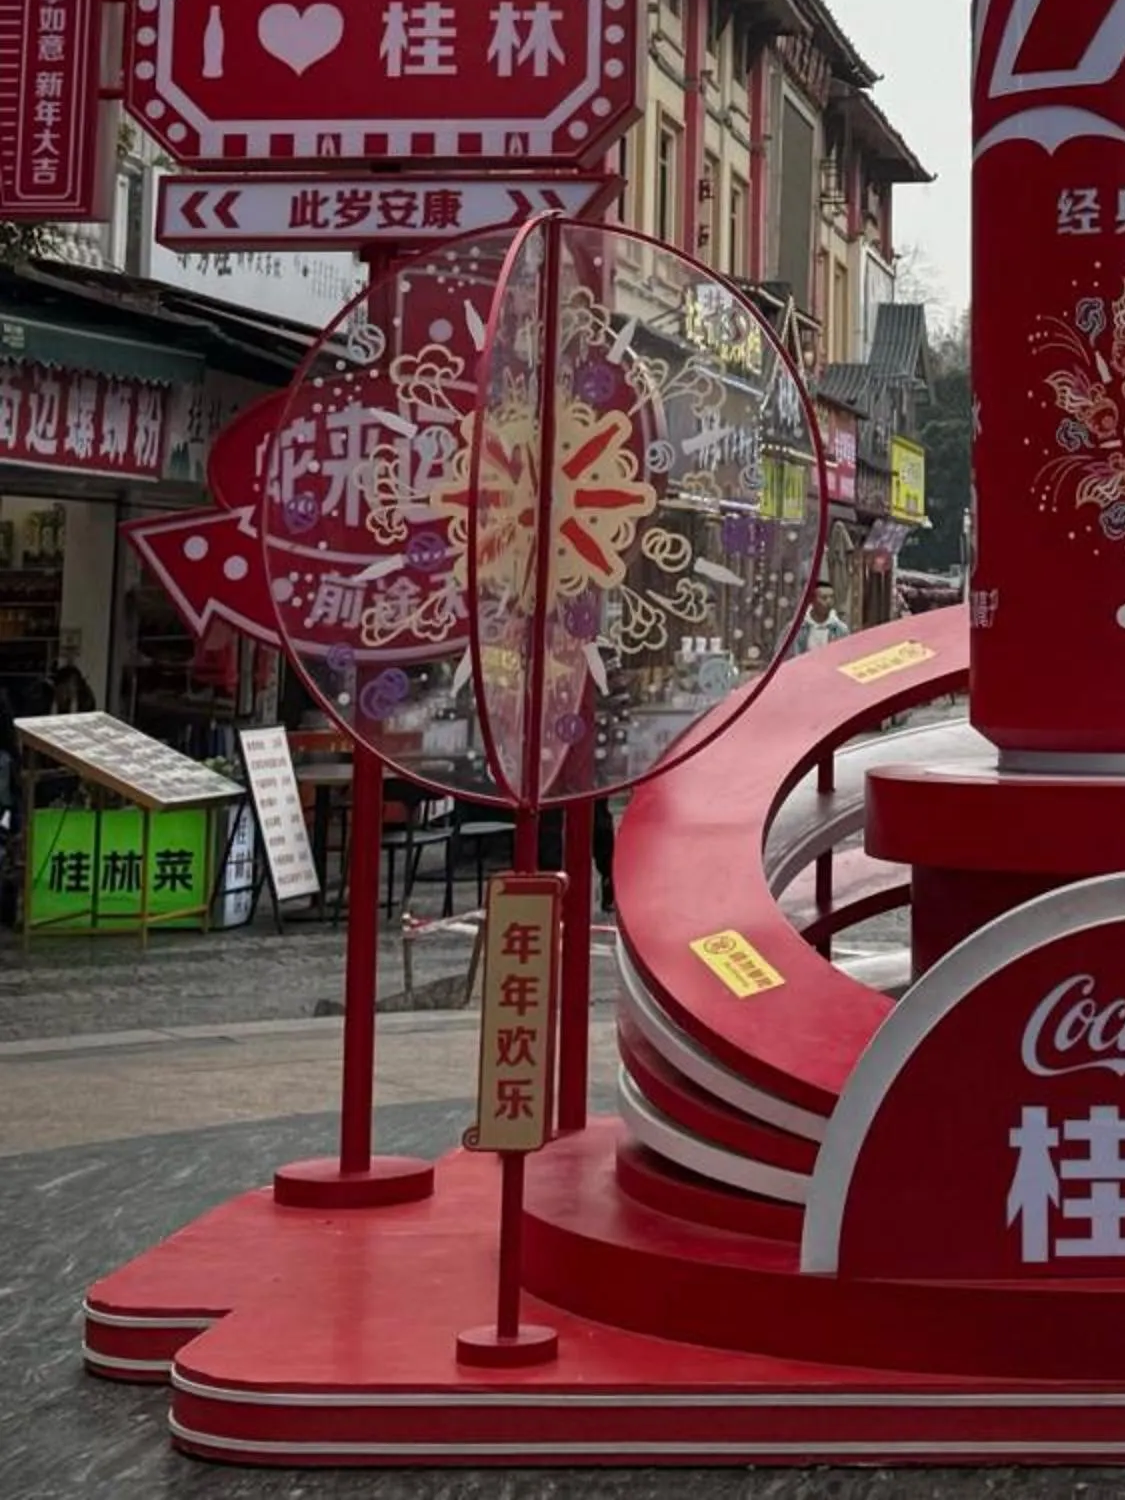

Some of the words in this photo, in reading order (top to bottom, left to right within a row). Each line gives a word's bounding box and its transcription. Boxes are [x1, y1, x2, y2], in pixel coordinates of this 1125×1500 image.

[379, 1, 566, 77] 桂林
[31, 71, 65, 185] 新年大吉
[288, 189, 464, 231] 此岁安康
[48, 849, 194, 894] 桂林菜
[494, 921, 542, 1121] 年年欢乐
